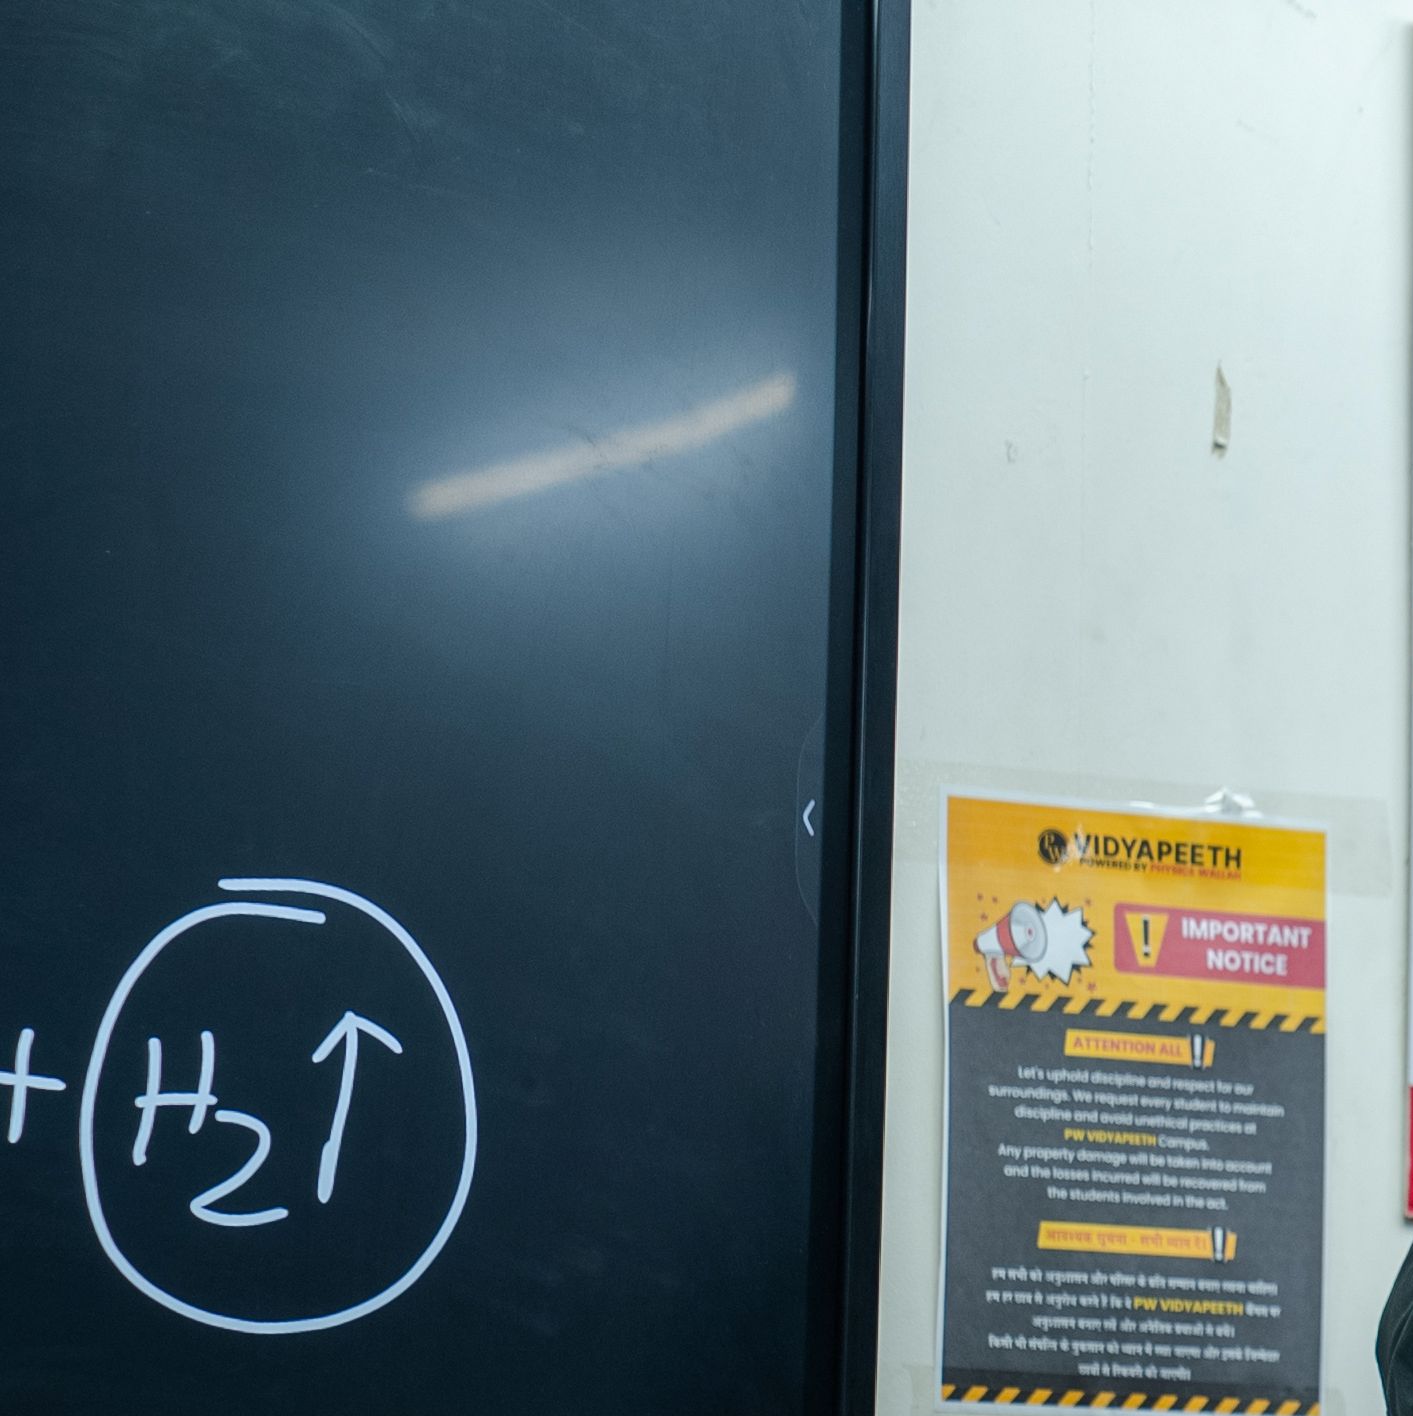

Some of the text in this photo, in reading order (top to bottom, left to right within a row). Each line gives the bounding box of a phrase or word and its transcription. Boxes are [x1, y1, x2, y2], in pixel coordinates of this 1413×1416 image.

[1075, 832, 1241, 869] VIDYAPEETH
[1079, 857, 1131, 871] POWERED
[1134, 862, 1147, 872] BY
[1181, 915, 1312, 949] IMPORTANT
[1206, 948, 1288, 976] NOTICE
[1073, 1037, 1183, 1056] ATTENTION ALL
[1018, 1065, 1254, 1096] Let's uphold discipline and respect for our
[988, 1084, 1285, 1117] surroundings. We request every student to maintain
[1014, 1104, 1257, 1135] discipline and avoid unethical practices at
[1063, 1127, 1210, 1152] PW VIDYAPEETH Campus.
[998, 1143, 1272, 1175] Any property damage will be taken into account
[1004, 1164, 1266, 1194] and the losses incurred will be recovered from
[1047, 1185, 1068, 1200] the
[1069, 1188, 1120, 1204] students
[1122, 1190, 1171, 1206] involved
[1172, 1194, 1184, 1207] in
[1185, 1194, 1204, 1209] the
[1133, 1296, 1158, 1311] PW
[1159, 1298, 1244, 1315] VIDYAPEETH
